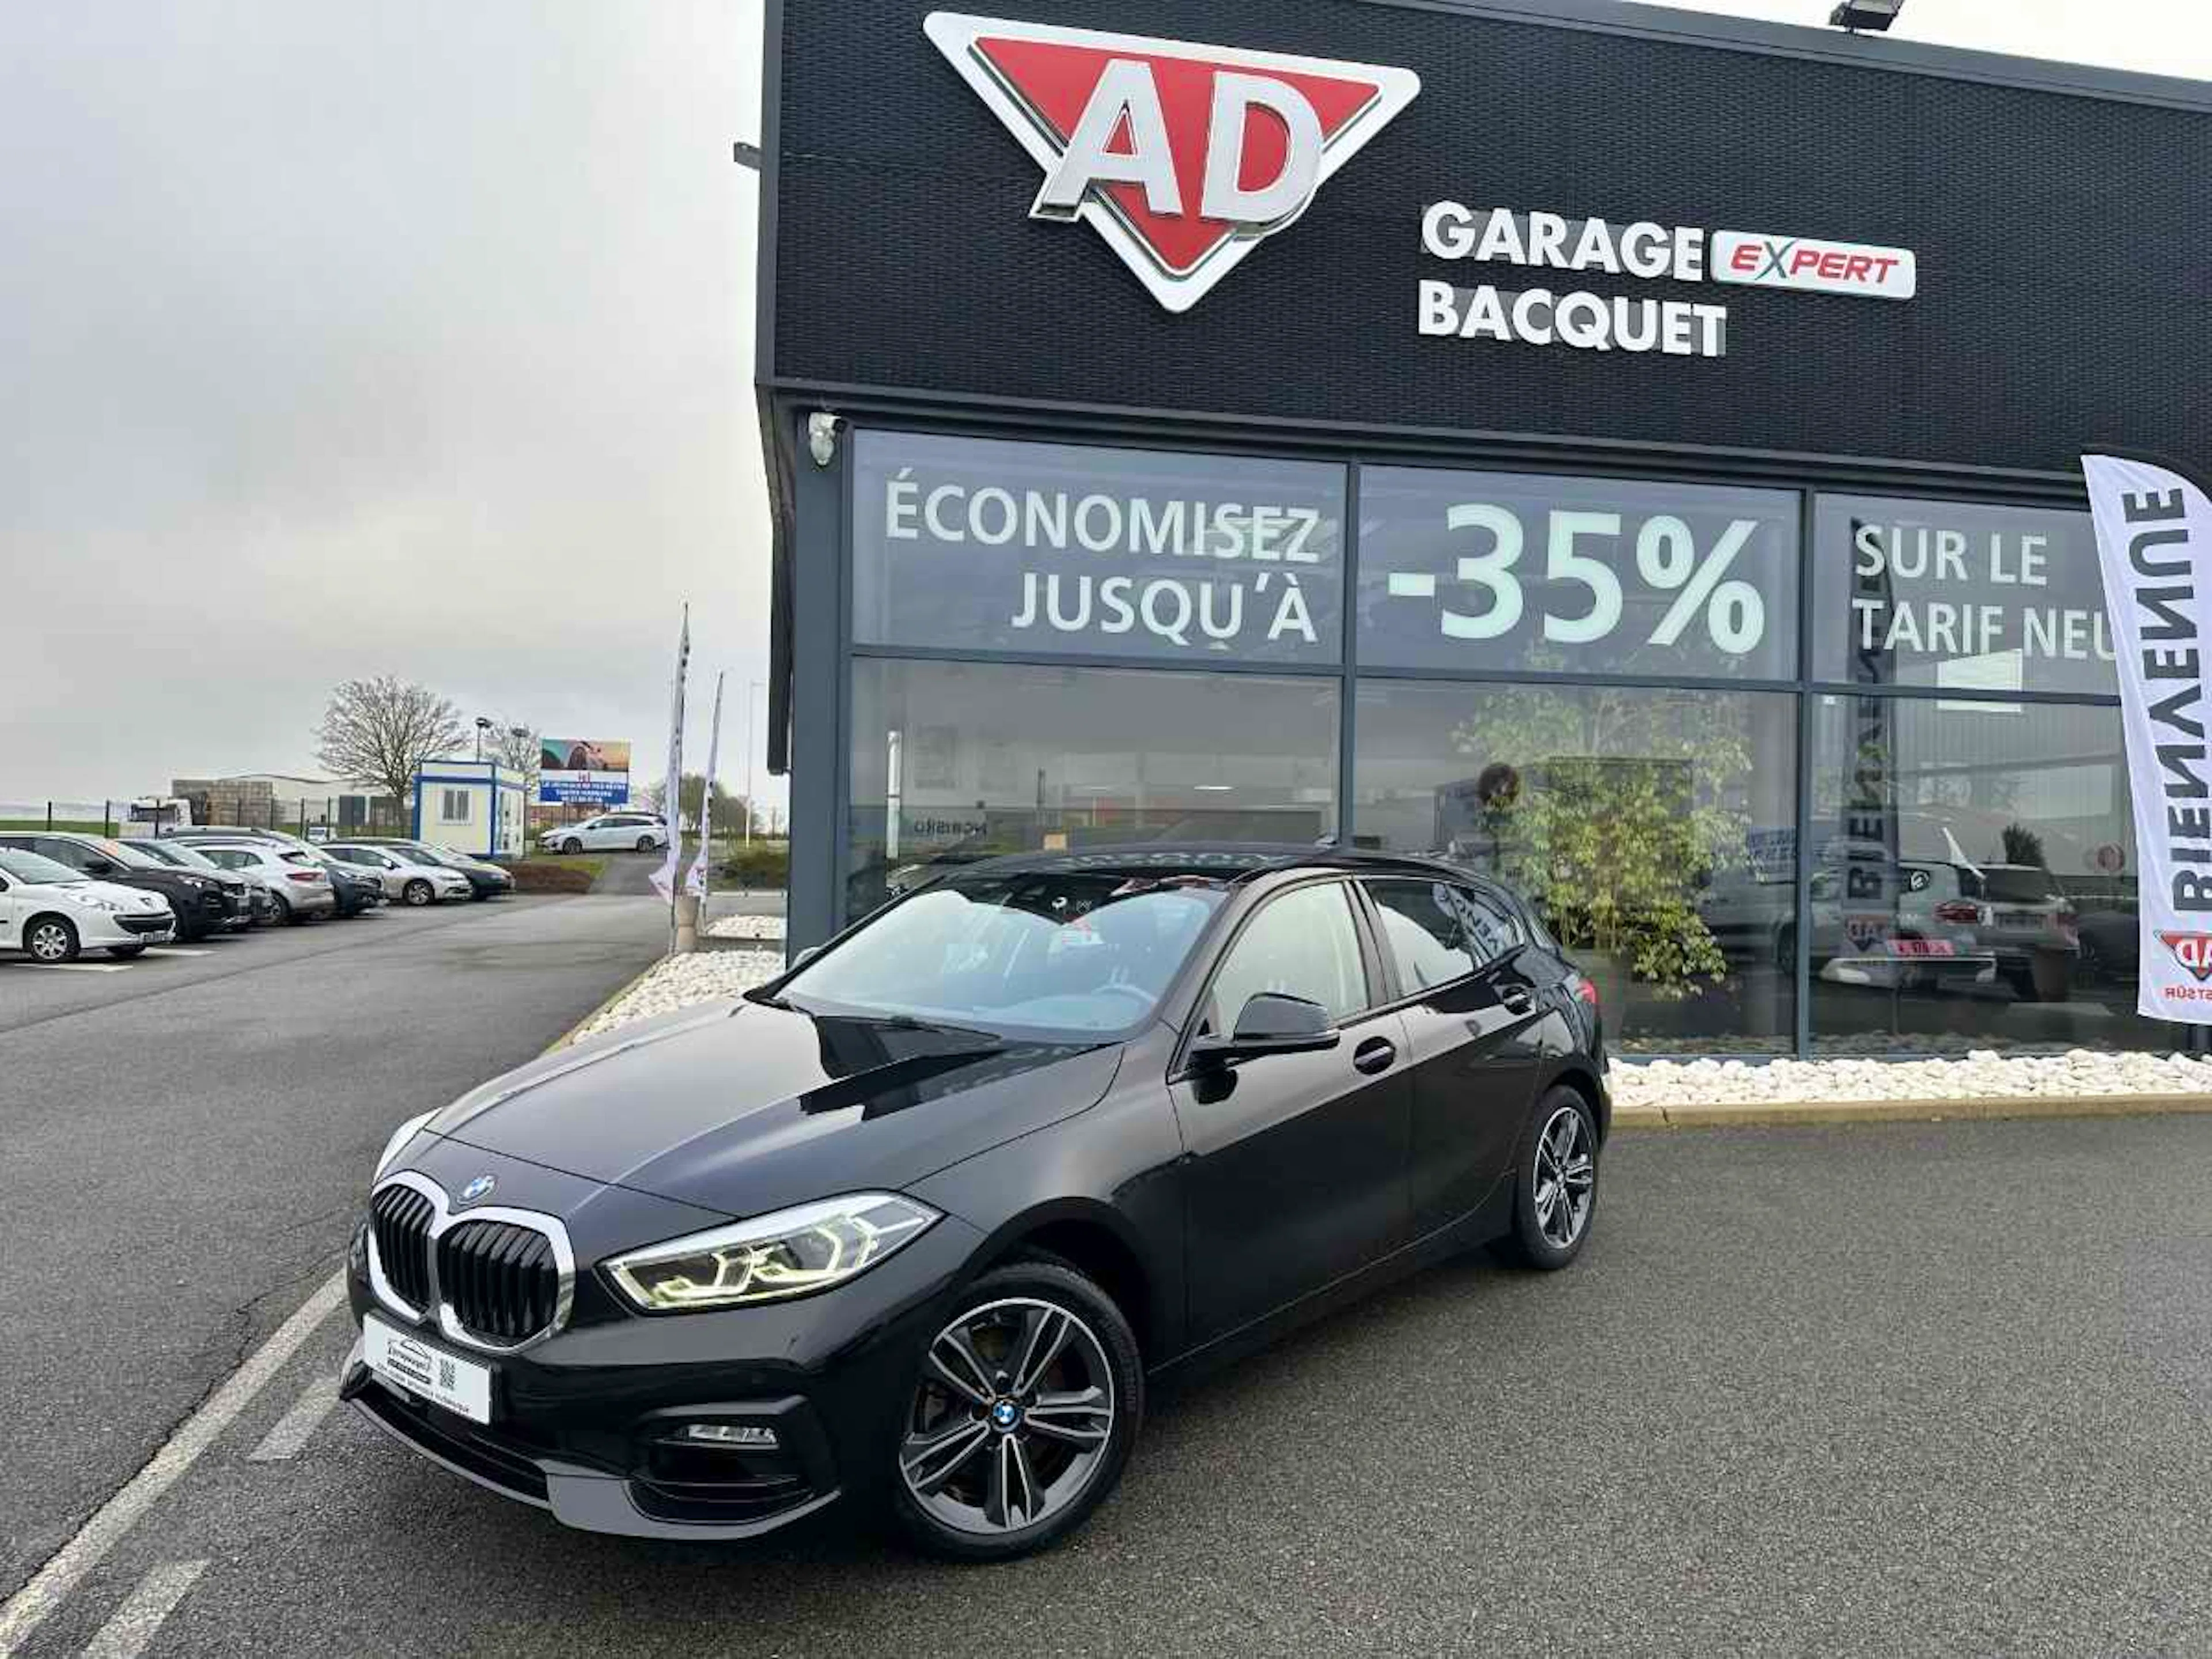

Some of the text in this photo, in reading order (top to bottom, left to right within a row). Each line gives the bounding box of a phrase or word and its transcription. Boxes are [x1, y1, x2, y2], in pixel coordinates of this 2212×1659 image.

[1031, 58, 1324, 225] AD
[1422, 200, 1705, 282] GARAGE
[1418, 279, 1727, 357] BACQUET
[886, 468, 1320, 563] ÉCONOMISEZ
[1854, 523, 2048, 586] SUR LE
[1011, 572, 1317, 646] JUSQU'À
[1388, 503, 1765, 654] -35%
[1852, 597, 2003, 654] TARIF
